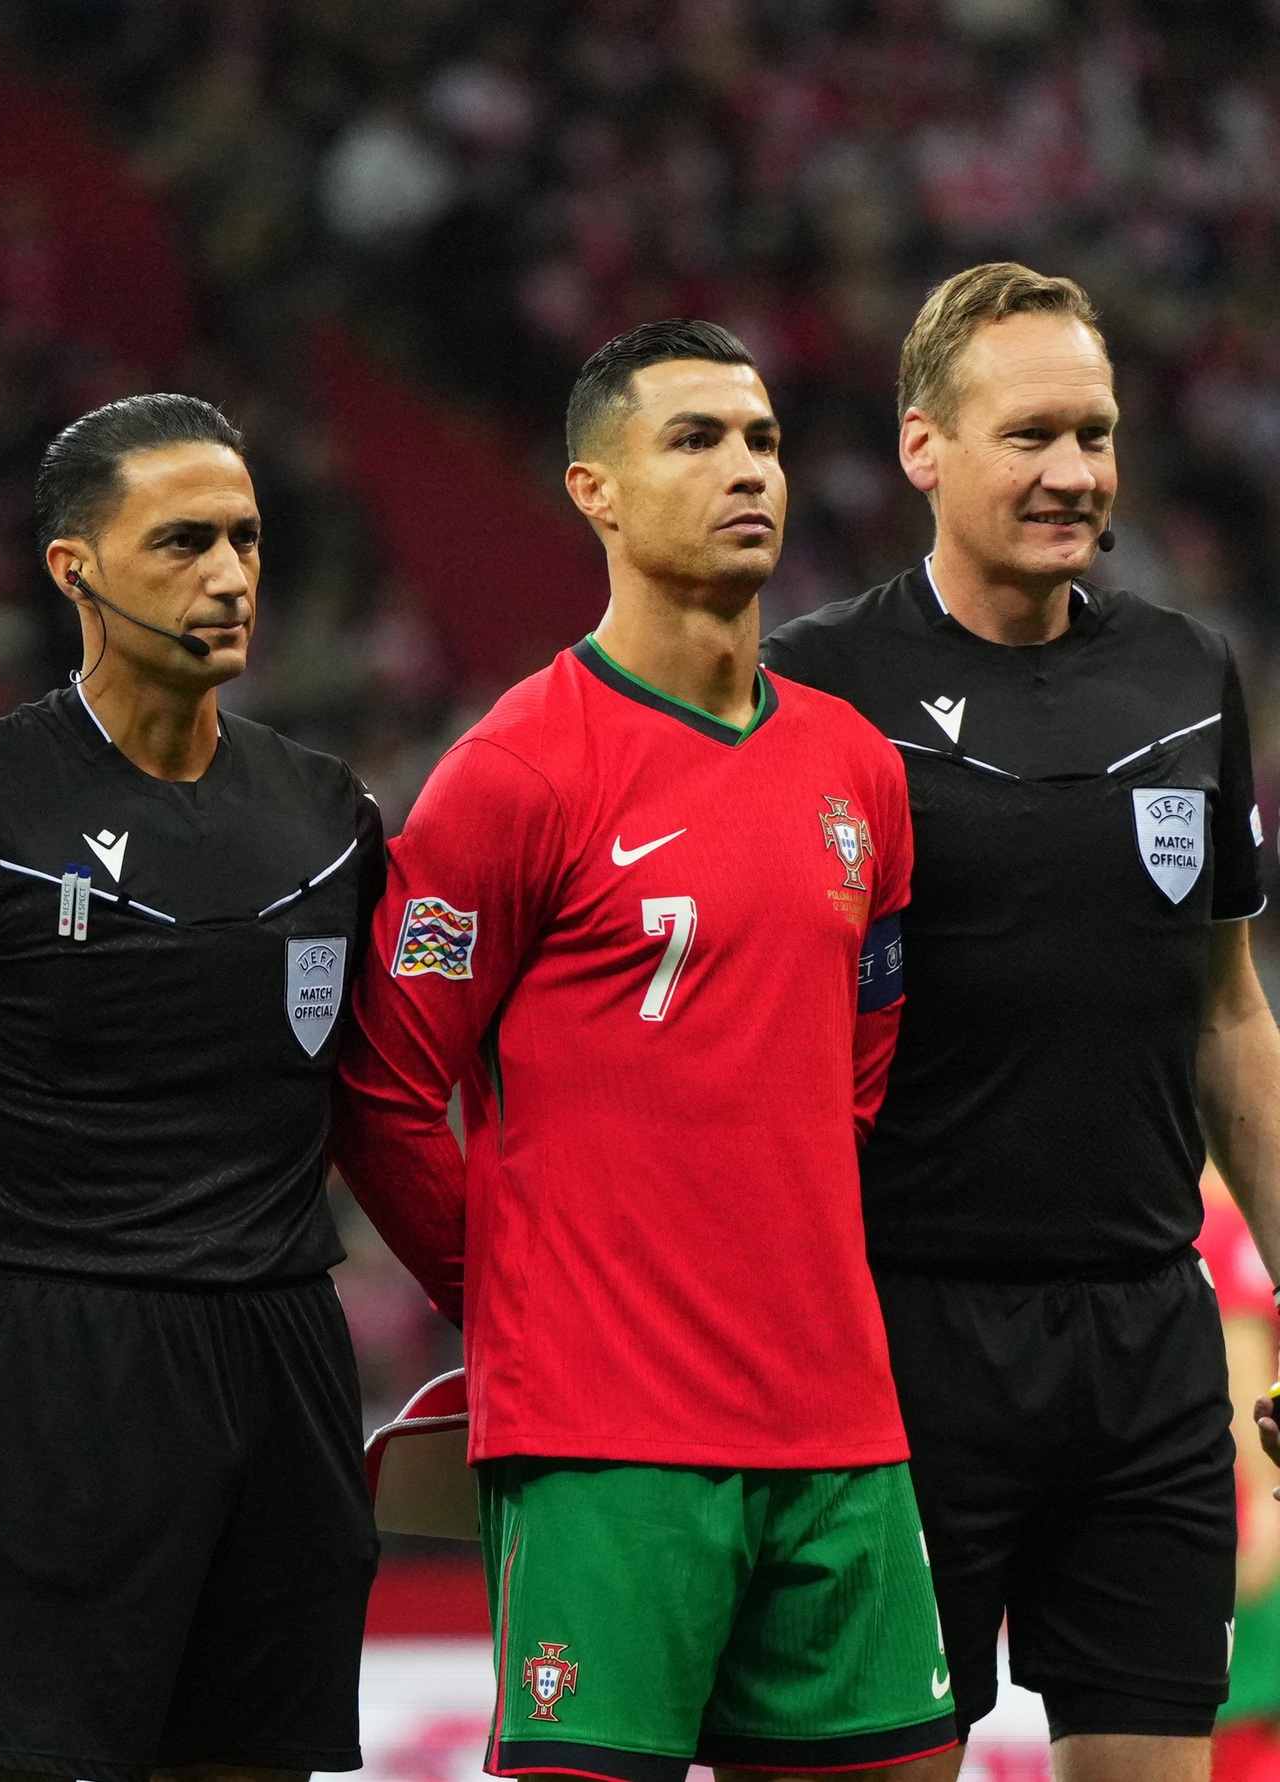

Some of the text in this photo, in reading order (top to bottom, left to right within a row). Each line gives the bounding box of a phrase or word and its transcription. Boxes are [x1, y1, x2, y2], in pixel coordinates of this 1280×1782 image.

[1150, 800, 1193, 822] UEFA
[1154, 836, 1194, 849] MATCH
[1150, 853, 1197, 867] OFFICIAL
[63, 883, 72, 916] RESPECT
[78, 888, 87, 920] RESPECT
[300, 951, 333, 971] UEFA
[639, 896, 698, 1022] 7
[300, 987, 332, 1000] MATCH
[294, 1005, 333, 1019] OFFICIAL
